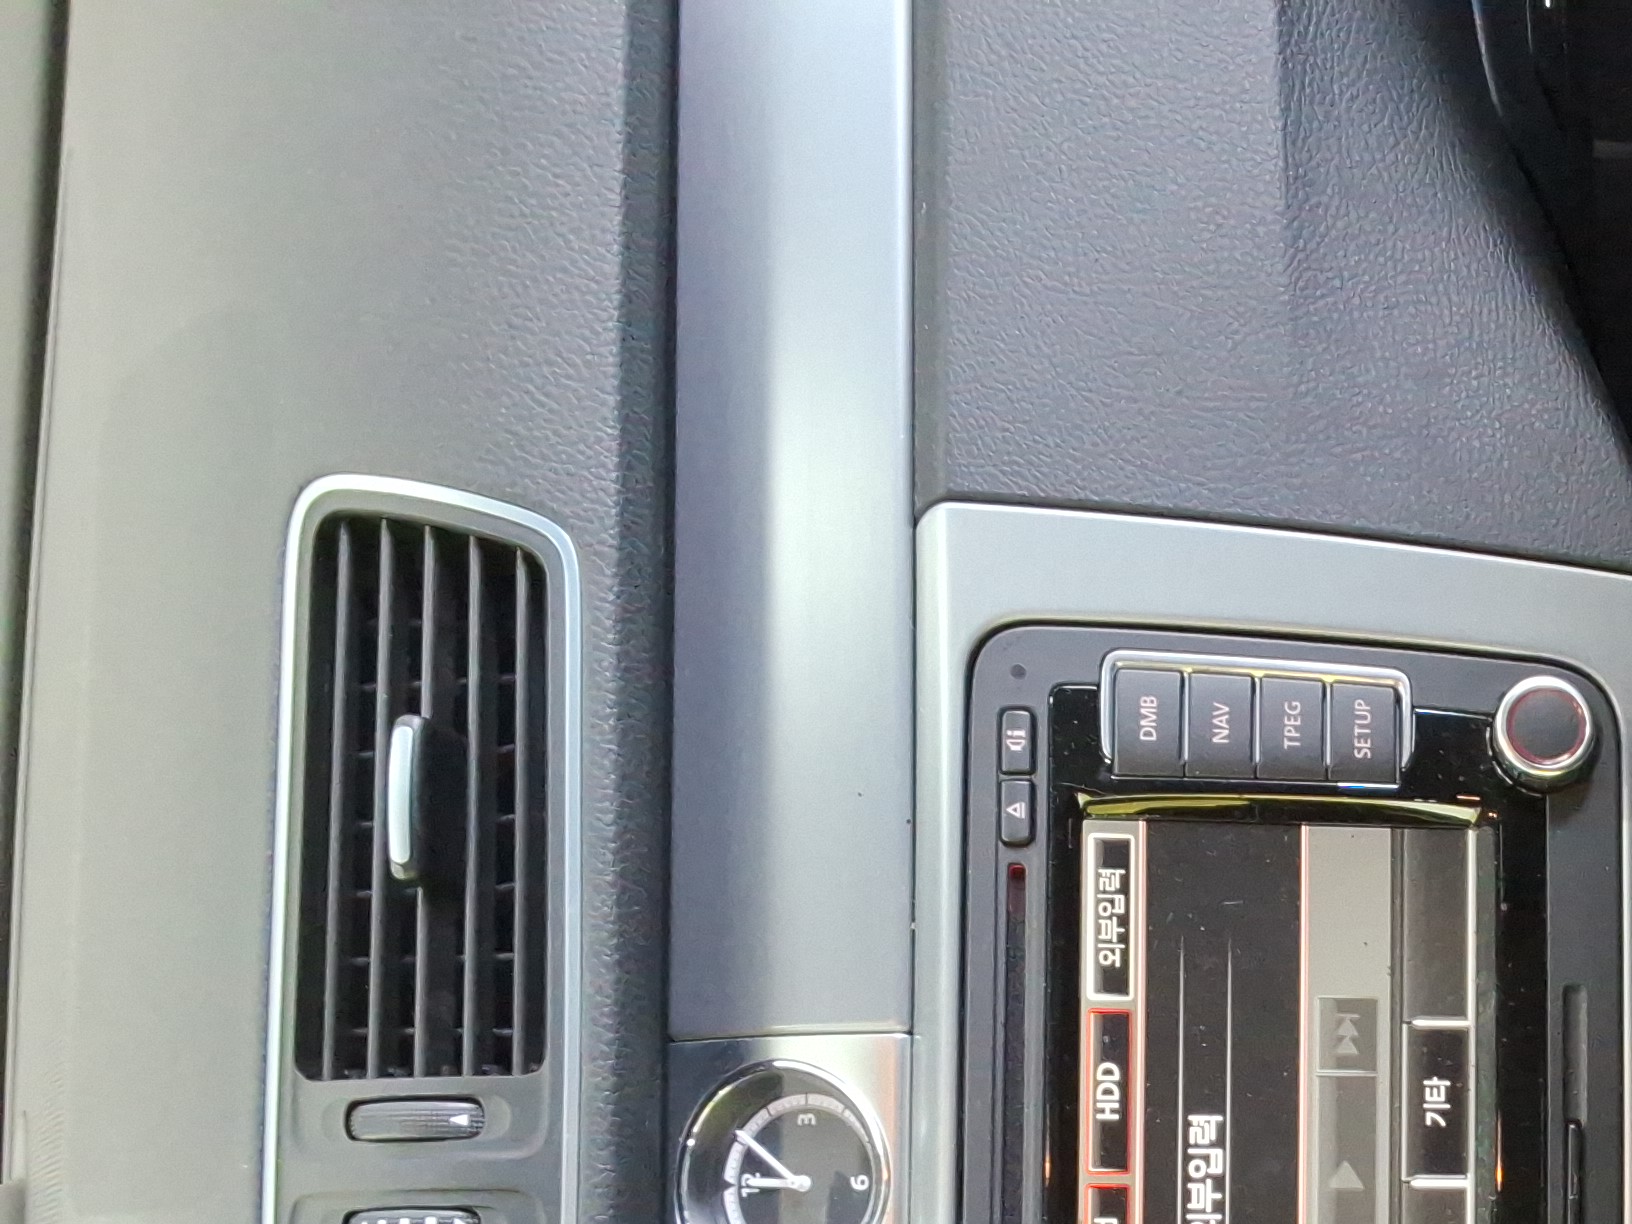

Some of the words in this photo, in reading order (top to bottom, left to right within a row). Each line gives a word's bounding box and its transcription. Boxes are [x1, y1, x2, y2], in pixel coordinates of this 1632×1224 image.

[1139, 695, 1158, 741] DMB
[1211, 701, 1230, 744] NAV
[1283, 700, 1302, 749] TPEG
[1353, 698, 1372, 759] SETUP
[1094, 867, 1126, 969] 외부입력
[1095, 1060, 1120, 1122] HDD
[1422, 1076, 1452, 1127] 기타
[796, 1112, 817, 1126] 3
[849, 1174, 870, 1191] 6
